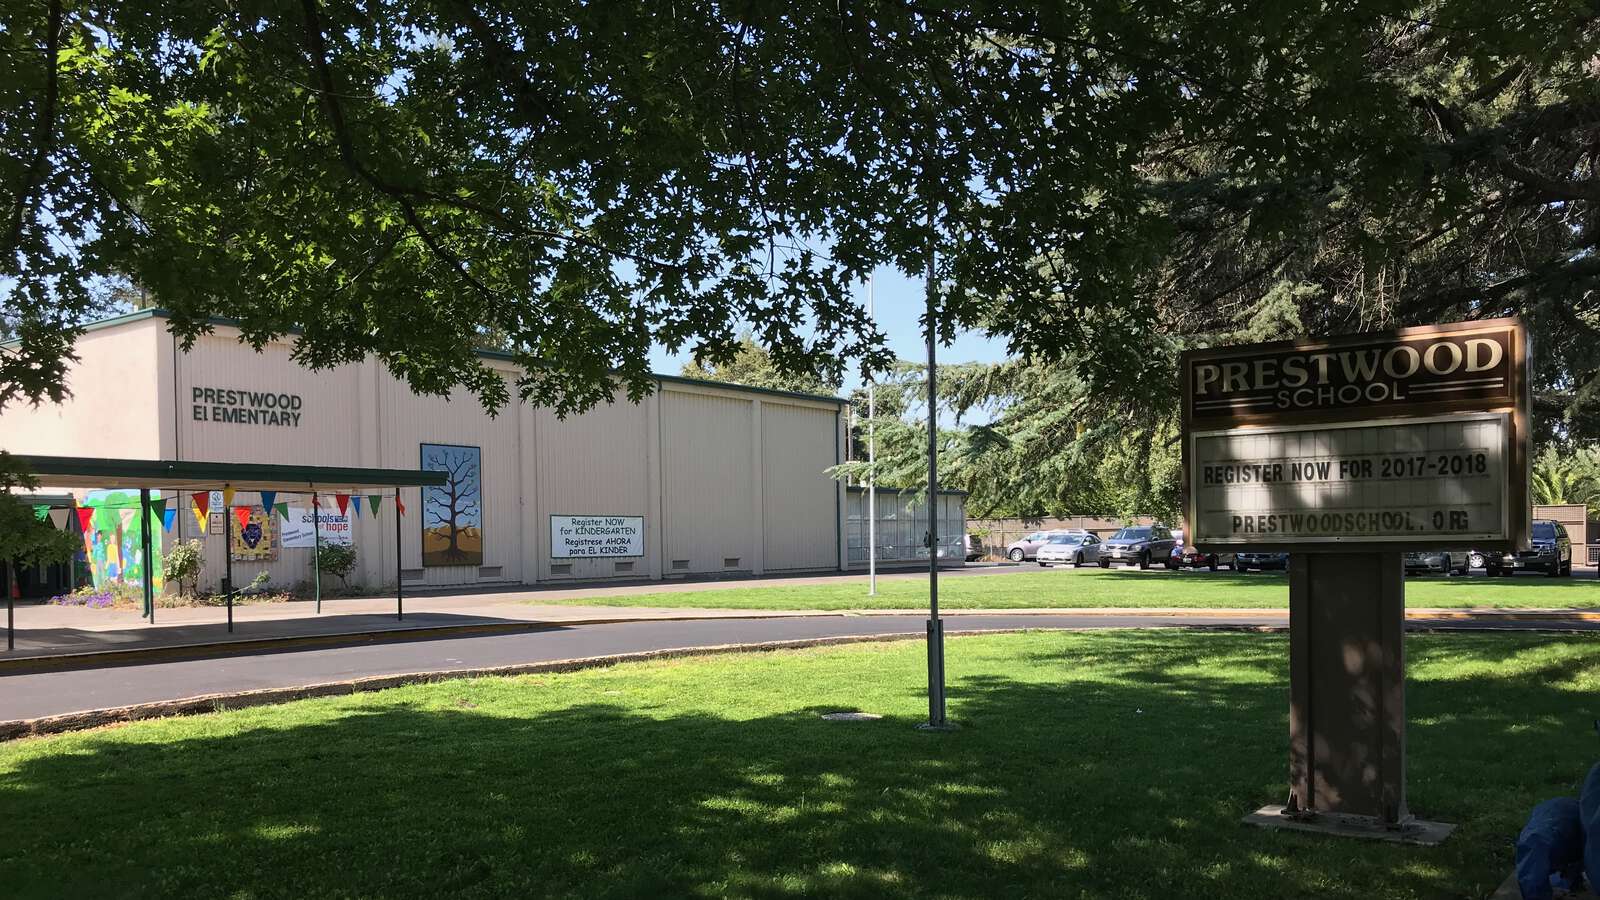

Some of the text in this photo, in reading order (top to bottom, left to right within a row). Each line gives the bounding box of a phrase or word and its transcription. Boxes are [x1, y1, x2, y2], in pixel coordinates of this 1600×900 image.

[1195, 338, 1503, 395] PRESTWOOD
[192, 387, 302, 410] PRESTWOOD
[1276, 382, 1405, 409] SCHOOL
[193, 405, 301, 427] ELEMENTARY
[1204, 453, 1487, 484] REGISTER NOW FOR 2017-2018
[326, 523, 348, 533] hope
[560, 527, 636, 535] for KINDERGARTEN
[571, 518, 625, 527] Register NOW
[569, 548, 586, 556] para
[600, 546, 628, 554] KINDER
